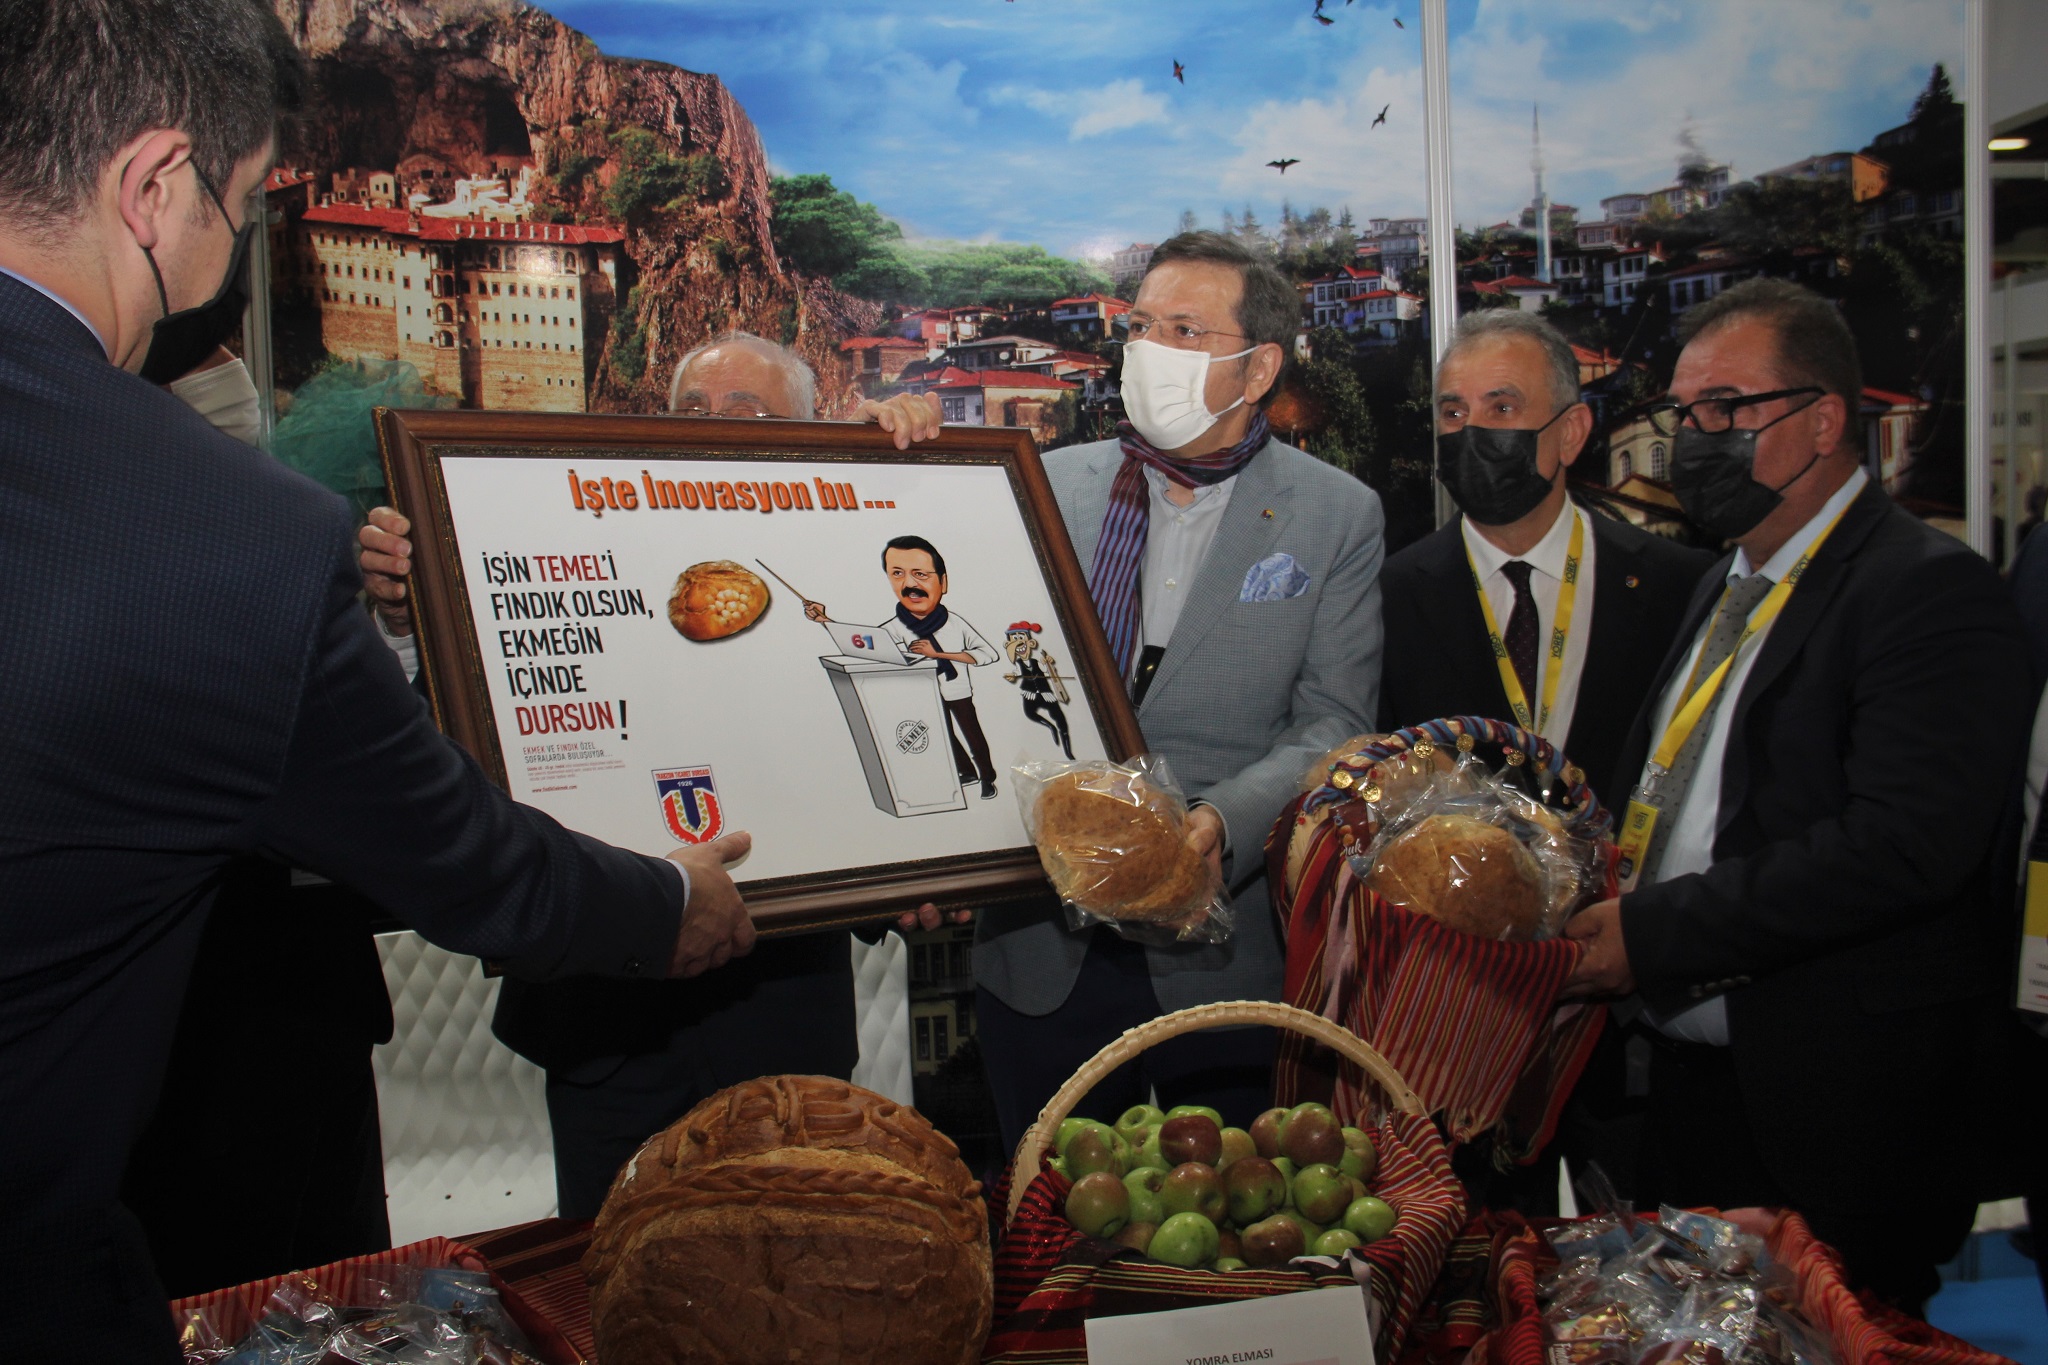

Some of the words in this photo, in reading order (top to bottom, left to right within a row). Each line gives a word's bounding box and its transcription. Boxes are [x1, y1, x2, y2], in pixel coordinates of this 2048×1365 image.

[567, 469, 638, 519] İşte
[641, 469, 812, 513] İnovasyon
[482, 551, 532, 587] İŞİN
[1563, 555, 1579, 584] YOREX
[490, 592, 571, 622] FINDIK
[572, 588, 655, 621] OLSUN,
[498, 622, 604, 658] EKMEĞİN
[850, 633, 875, 651] 61
[1551, 627, 1565, 660] YOREX
[505, 661, 587, 699] İÇİNDE
[523, 744, 545, 755] EKMEK
[546, 744, 556, 754] VE
[557, 743, 579, 752] FINDIK
[579, 741, 596, 751] ÖZEL
[899, 722, 927, 751] EKMEK
[525, 752, 566, 764] SOFRALARDA
[1186, 1355, 1230, 1365] YOMRA
[1232, 1348, 1274, 1364] ELMASI
